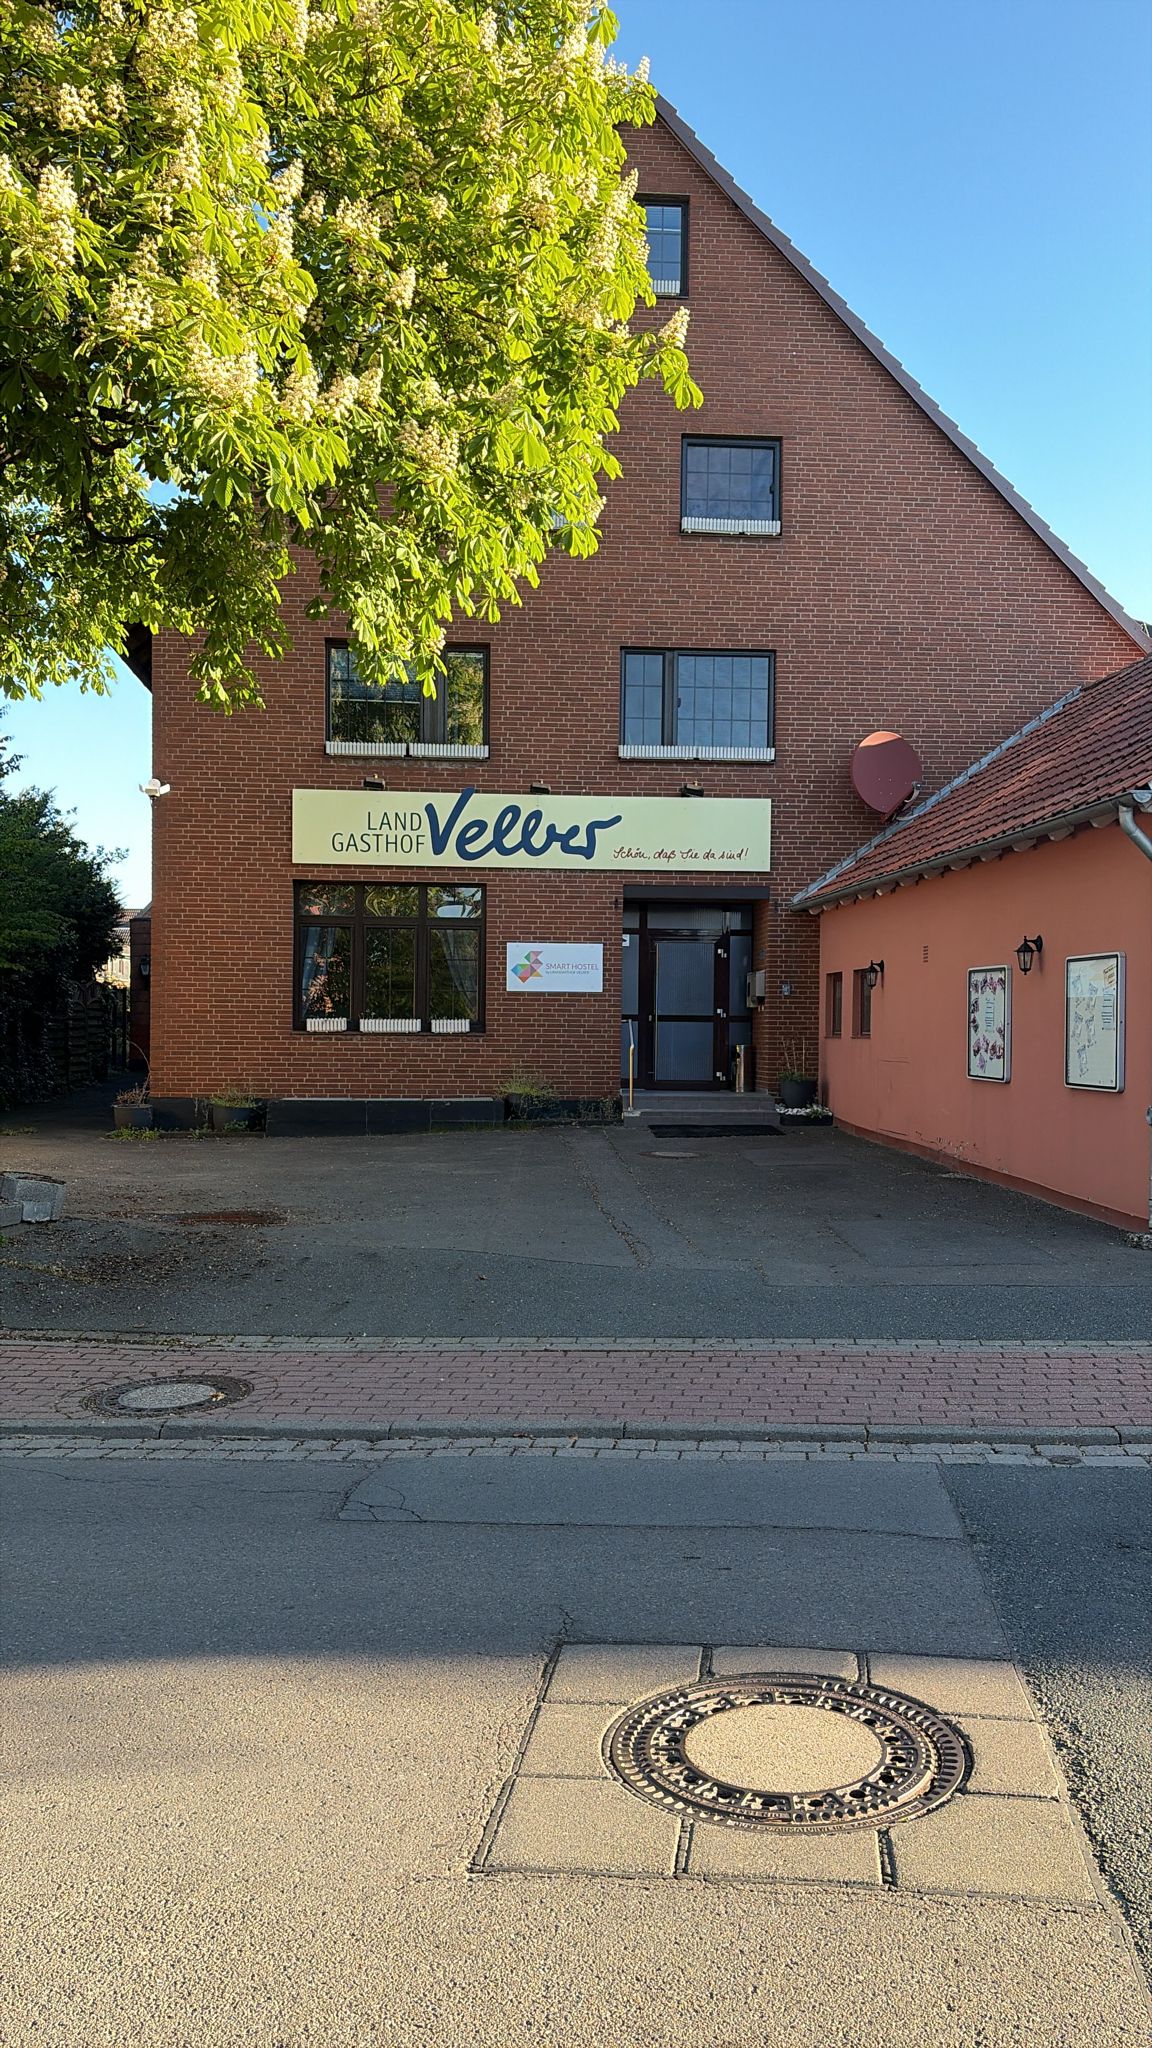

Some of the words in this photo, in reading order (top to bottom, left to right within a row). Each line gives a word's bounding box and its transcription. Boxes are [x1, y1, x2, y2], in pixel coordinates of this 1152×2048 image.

[367, 811, 422, 832] LAND
[424, 787, 623, 861] Velber
[331, 832, 426, 854] GASTHOF
[613, 846, 651, 860] Schön,
[653, 848, 677, 862] daß
[680, 848, 700, 860] Sie
[702, 848, 717, 860] da
[719, 847, 749, 860] sind!
